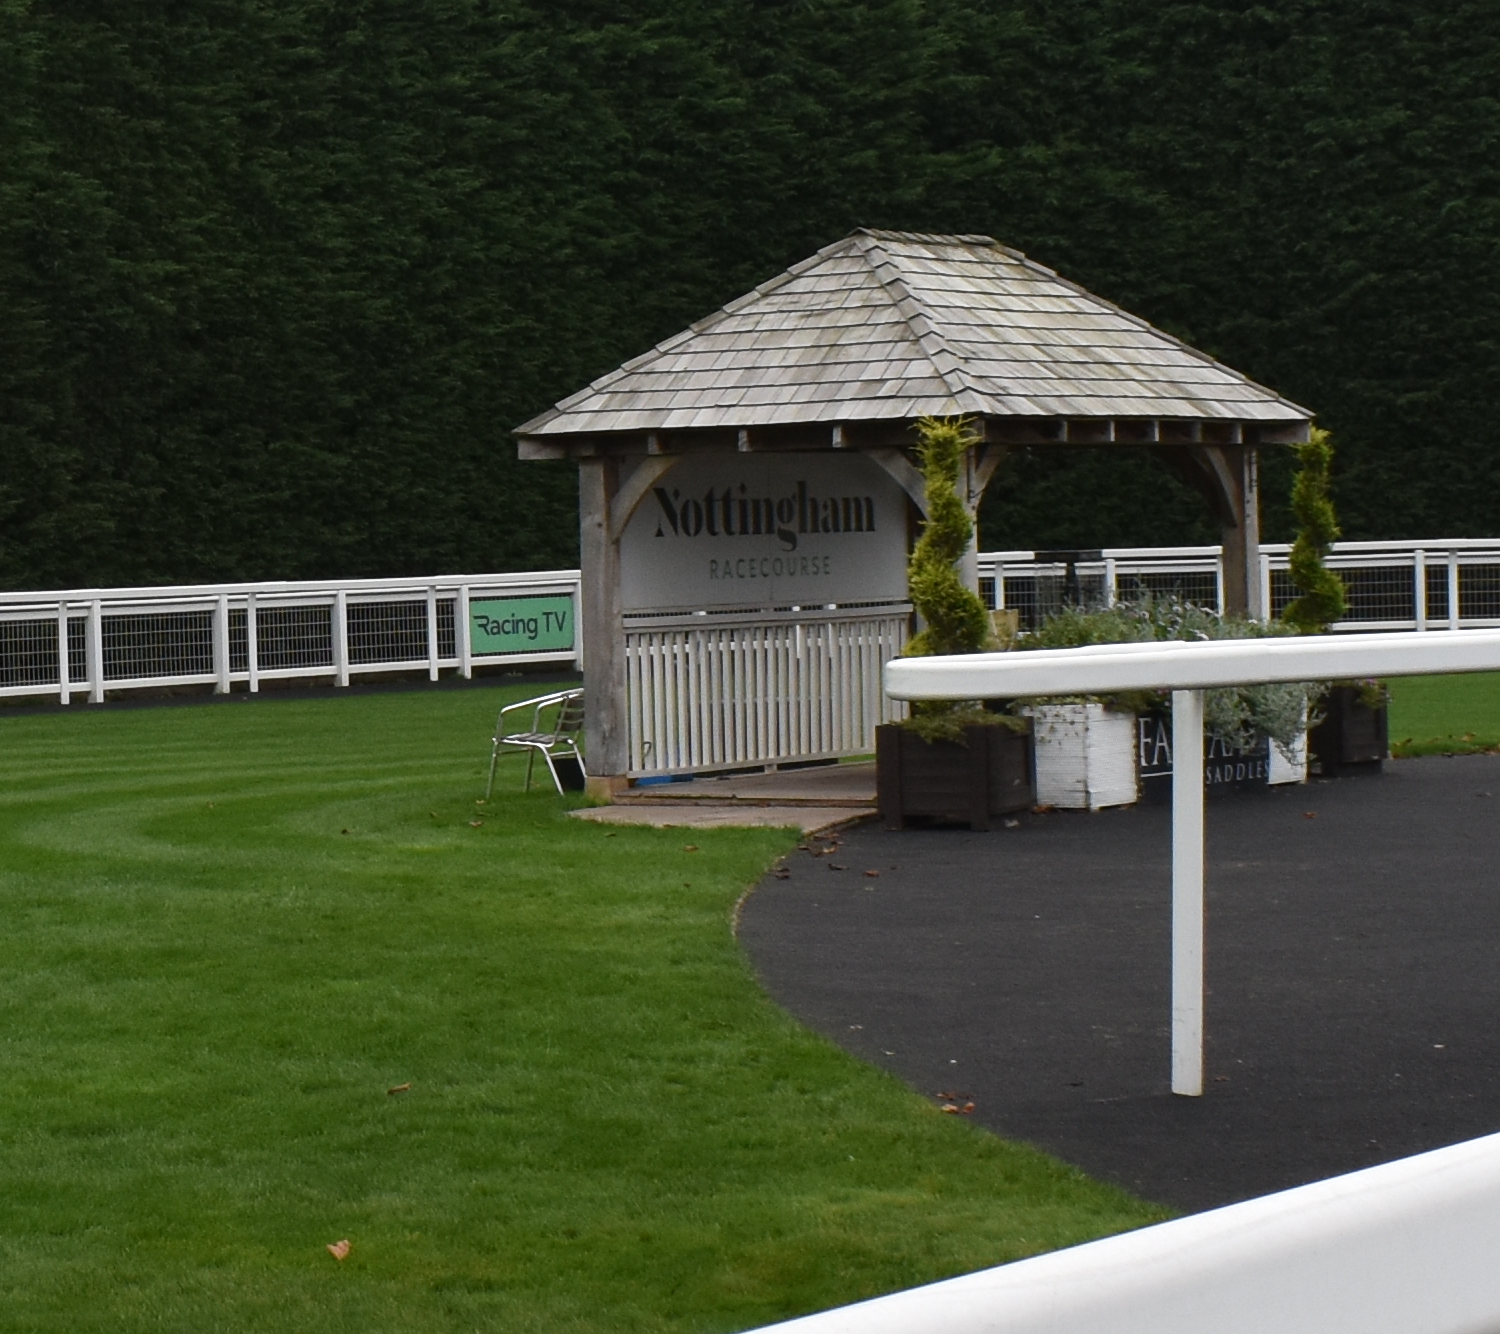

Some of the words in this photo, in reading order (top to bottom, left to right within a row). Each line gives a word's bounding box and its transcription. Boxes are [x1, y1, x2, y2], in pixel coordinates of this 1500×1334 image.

[652, 480, 876, 552] Nottingham
[709, 555, 832, 581] RACECOURSE
[472, 612, 539, 641] Racing
[542, 610, 567, 634] TV
[1206, 759, 1269, 785] SADDLES
